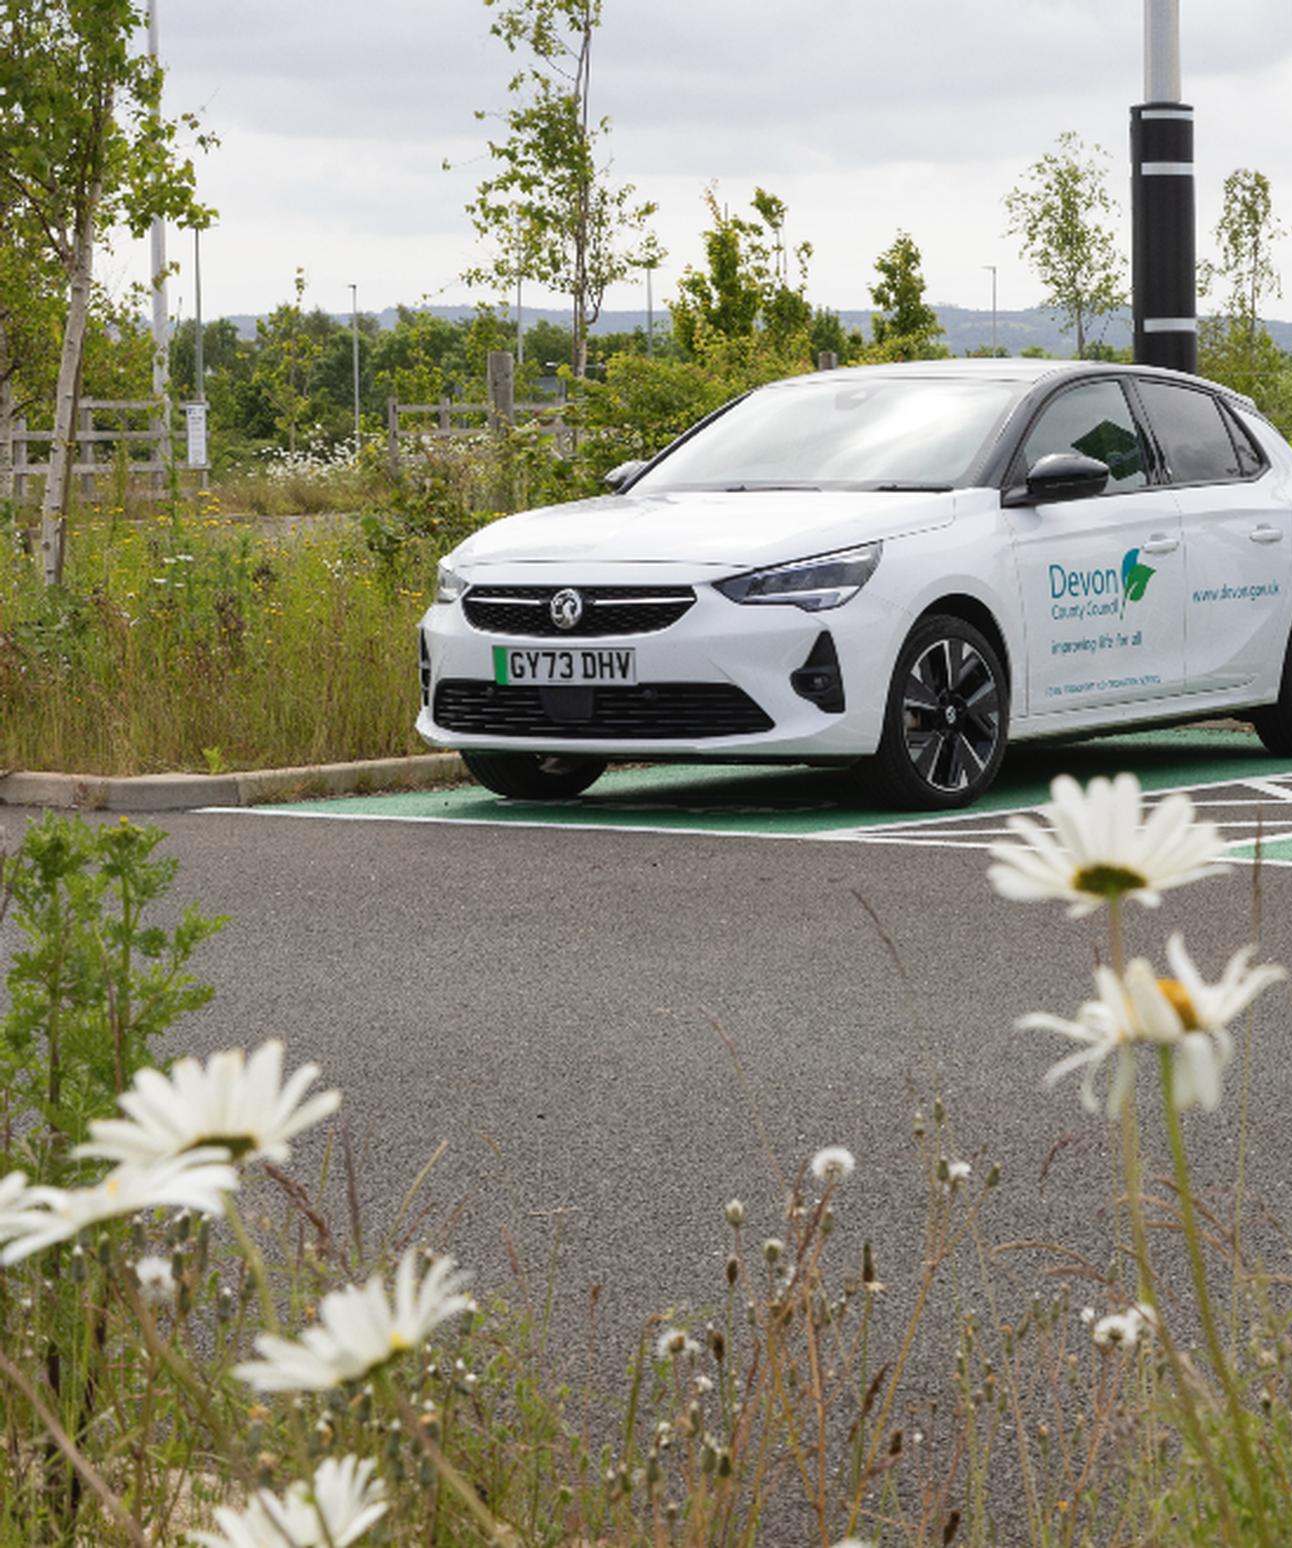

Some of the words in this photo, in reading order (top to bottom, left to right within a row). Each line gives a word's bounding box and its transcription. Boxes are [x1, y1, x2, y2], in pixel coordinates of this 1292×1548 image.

[1049, 564, 1119, 598] Devon
[1051, 604, 1085, 620] County
[1087, 598, 1118, 616] Council
[1051, 637, 1097, 655] improving
[1116, 632, 1128, 646] for
[1131, 630, 1142, 645] all
[510, 652, 573, 679] GY73
[581, 652, 630, 679] DHV
